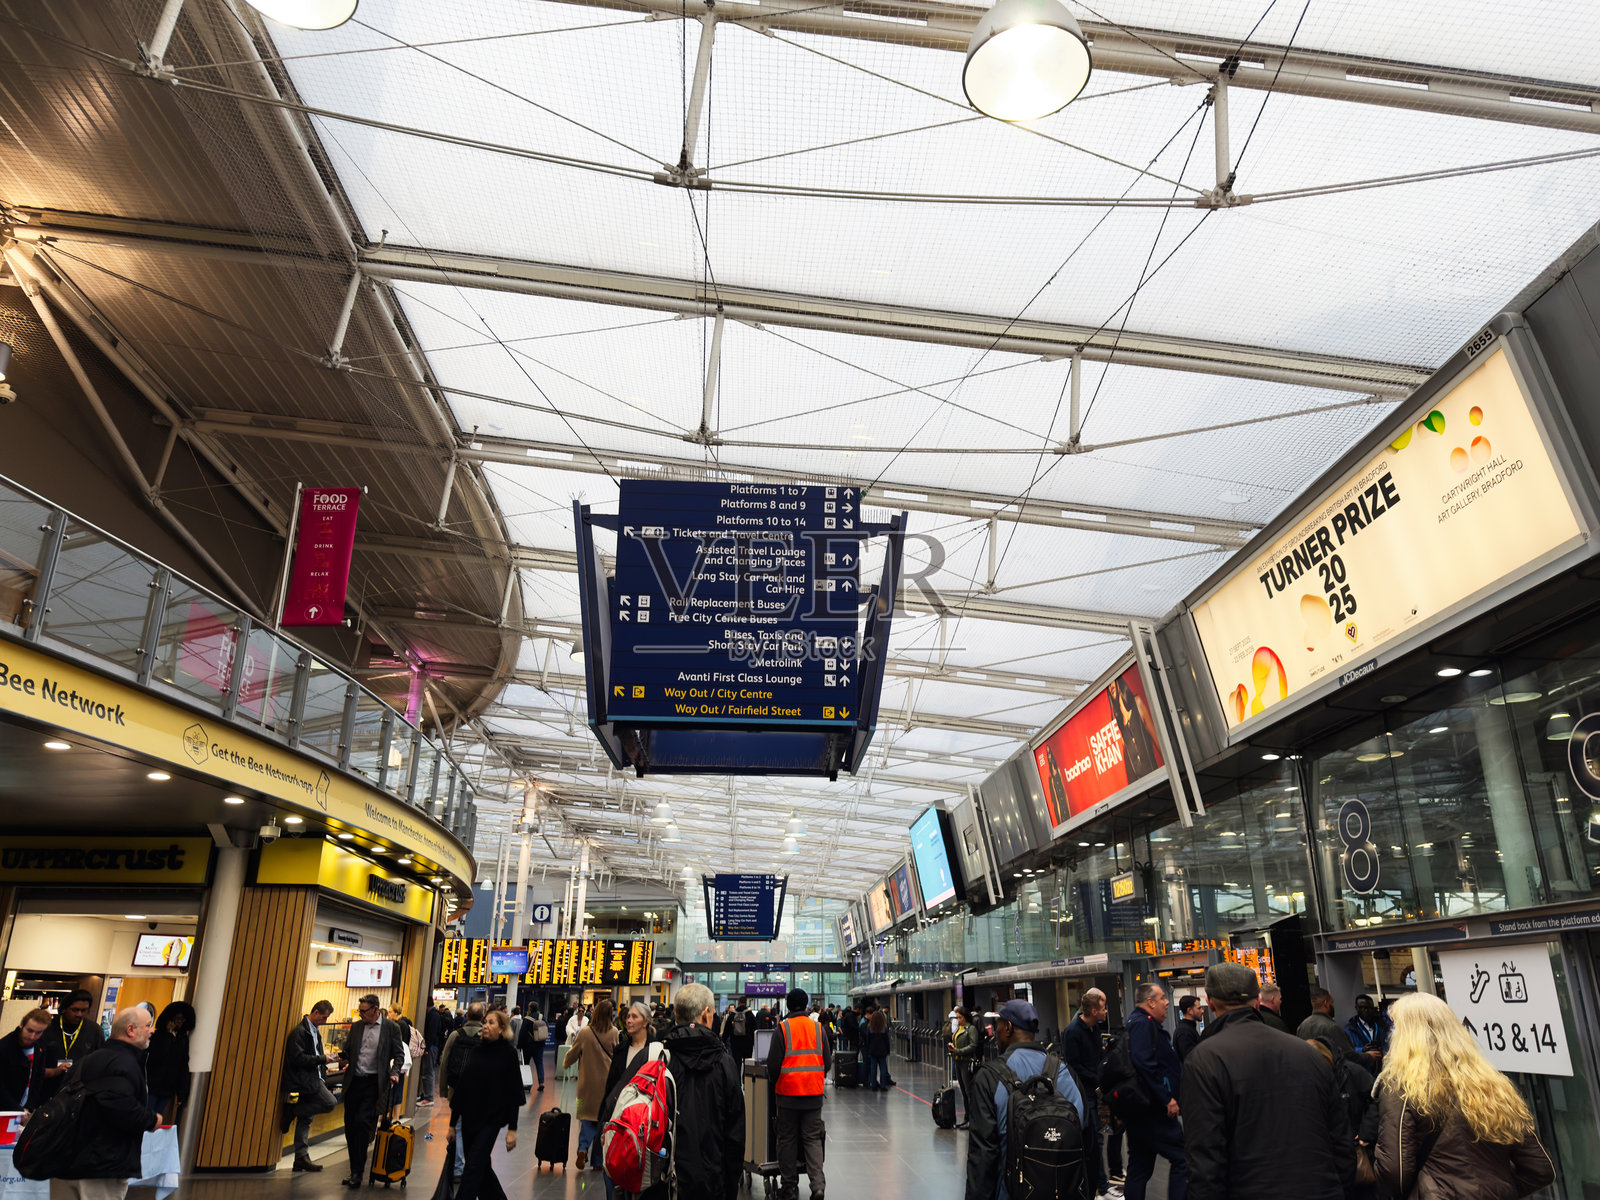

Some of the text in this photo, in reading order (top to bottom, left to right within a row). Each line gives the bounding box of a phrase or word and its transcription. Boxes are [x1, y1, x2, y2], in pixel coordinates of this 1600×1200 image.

[1467, 330, 1493, 357] 2655
[1441, 454, 1507, 505] CARTWRIGHT HALL
[313, 493, 348, 504] FOOD
[730, 485, 807, 496] Platforms 1 to 7
[1437, 459, 1524, 524] ART GALLERY, BRADFORD
[721, 499, 806, 510] Platforms 8 and 9
[1288, 511, 1327, 549] GROUNDBREAKING
[1325, 498, 1345, 517] BRITISH
[1343, 490, 1354, 502] ART
[1353, 486, 1360, 496] IN
[1358, 460, 1388, 487] BRADFORD
[716, 515, 806, 526] Platforms 10 to 14
[672, 528, 793, 541] Tickets and Travel Centre
[1259, 471, 1401, 600] TURNER PRIZE
[696, 545, 806, 558] Assisted Travel Lounge
[704, 556, 806, 568] and Changing Places
[692, 571, 805, 584] Long Stay Car Park and
[1318, 554, 1346, 594] 20
[765, 584, 805, 594] Car Hire
[669, 597, 786, 610] Rail Replacement Buses
[1329, 583, 1357, 624] 25
[668, 612, 778, 625] Free City Centre Buses
[724, 629, 804, 641] Buses, Taxis and
[708, 639, 804, 652] Short Stay Car Park
[755, 658, 803, 667] Metrolink
[678, 671, 803, 686] Avanti First Class Lounge
[1342, 662, 1375, 685] JCDecaux
[0, 662, 125, 726] Bee Network
[664, 688, 687, 700] Way
[689, 688, 708, 698] Out
[717, 689, 737, 701] City
[740, 689, 773, 699] Centre
[675, 704, 698, 716] Way
[700, 704, 720, 715] Out
[728, 705, 769, 716] Fairfield
[771, 706, 802, 716] Street
[1090, 718, 1122, 755] SAFFIE
[1094, 742, 1123, 775] KHAN
[211, 743, 314, 795] Get the Bee Network app
[1064, 756, 1092, 782] boohoo
[365, 802, 391, 828] Welcome
[392, 817, 398, 830] to
[1338, 799, 1380, 894] 8
[1498, 922, 1516, 932] Stand
[1517, 920, 1531, 930] back
[1532, 919, 1547, 929] from
[1548, 917, 1559, 927] the
[1561, 915, 1590, 928] platform
[1483, 1022, 1557, 1054] 13 & 14
